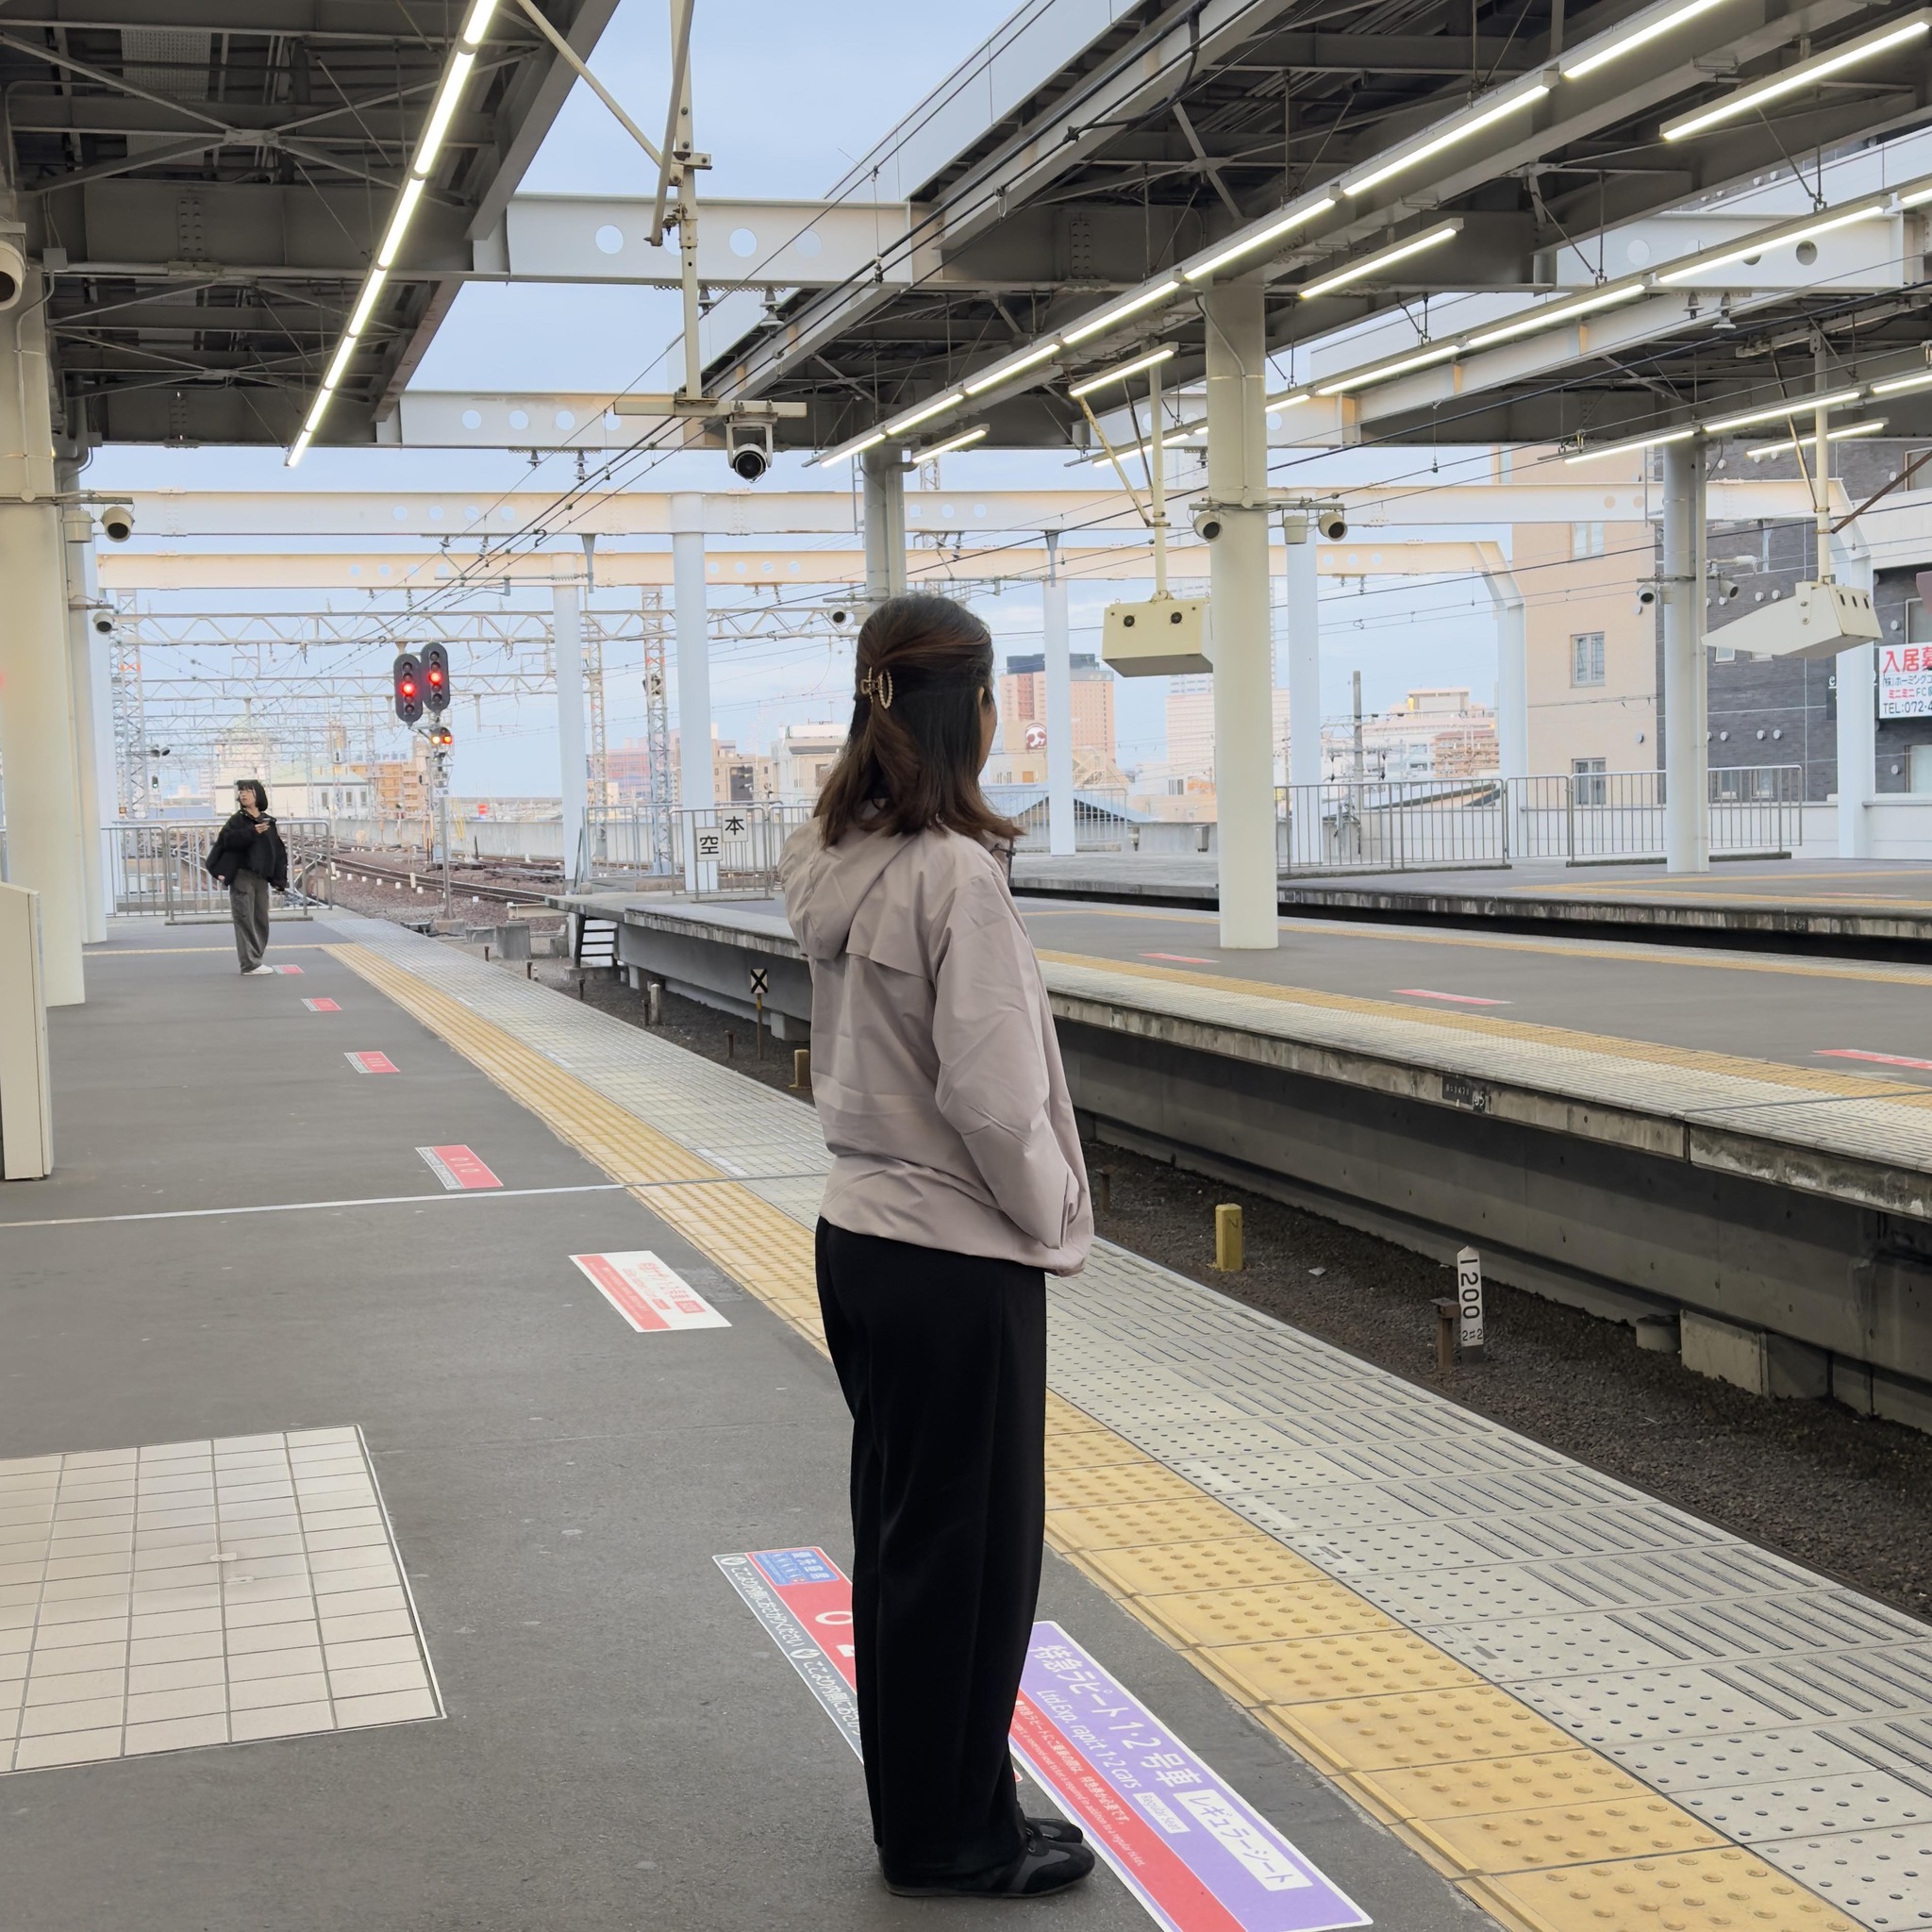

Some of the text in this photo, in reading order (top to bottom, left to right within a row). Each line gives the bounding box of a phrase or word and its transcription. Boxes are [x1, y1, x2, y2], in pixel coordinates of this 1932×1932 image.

[724, 816, 745, 836] 本
[699, 835, 720, 855] 空
[1460, 1258, 1480, 1319] 1200
[1110, 1768, 1142, 1789] cars
[1188, 1796, 1294, 1883] レギュラーシート
